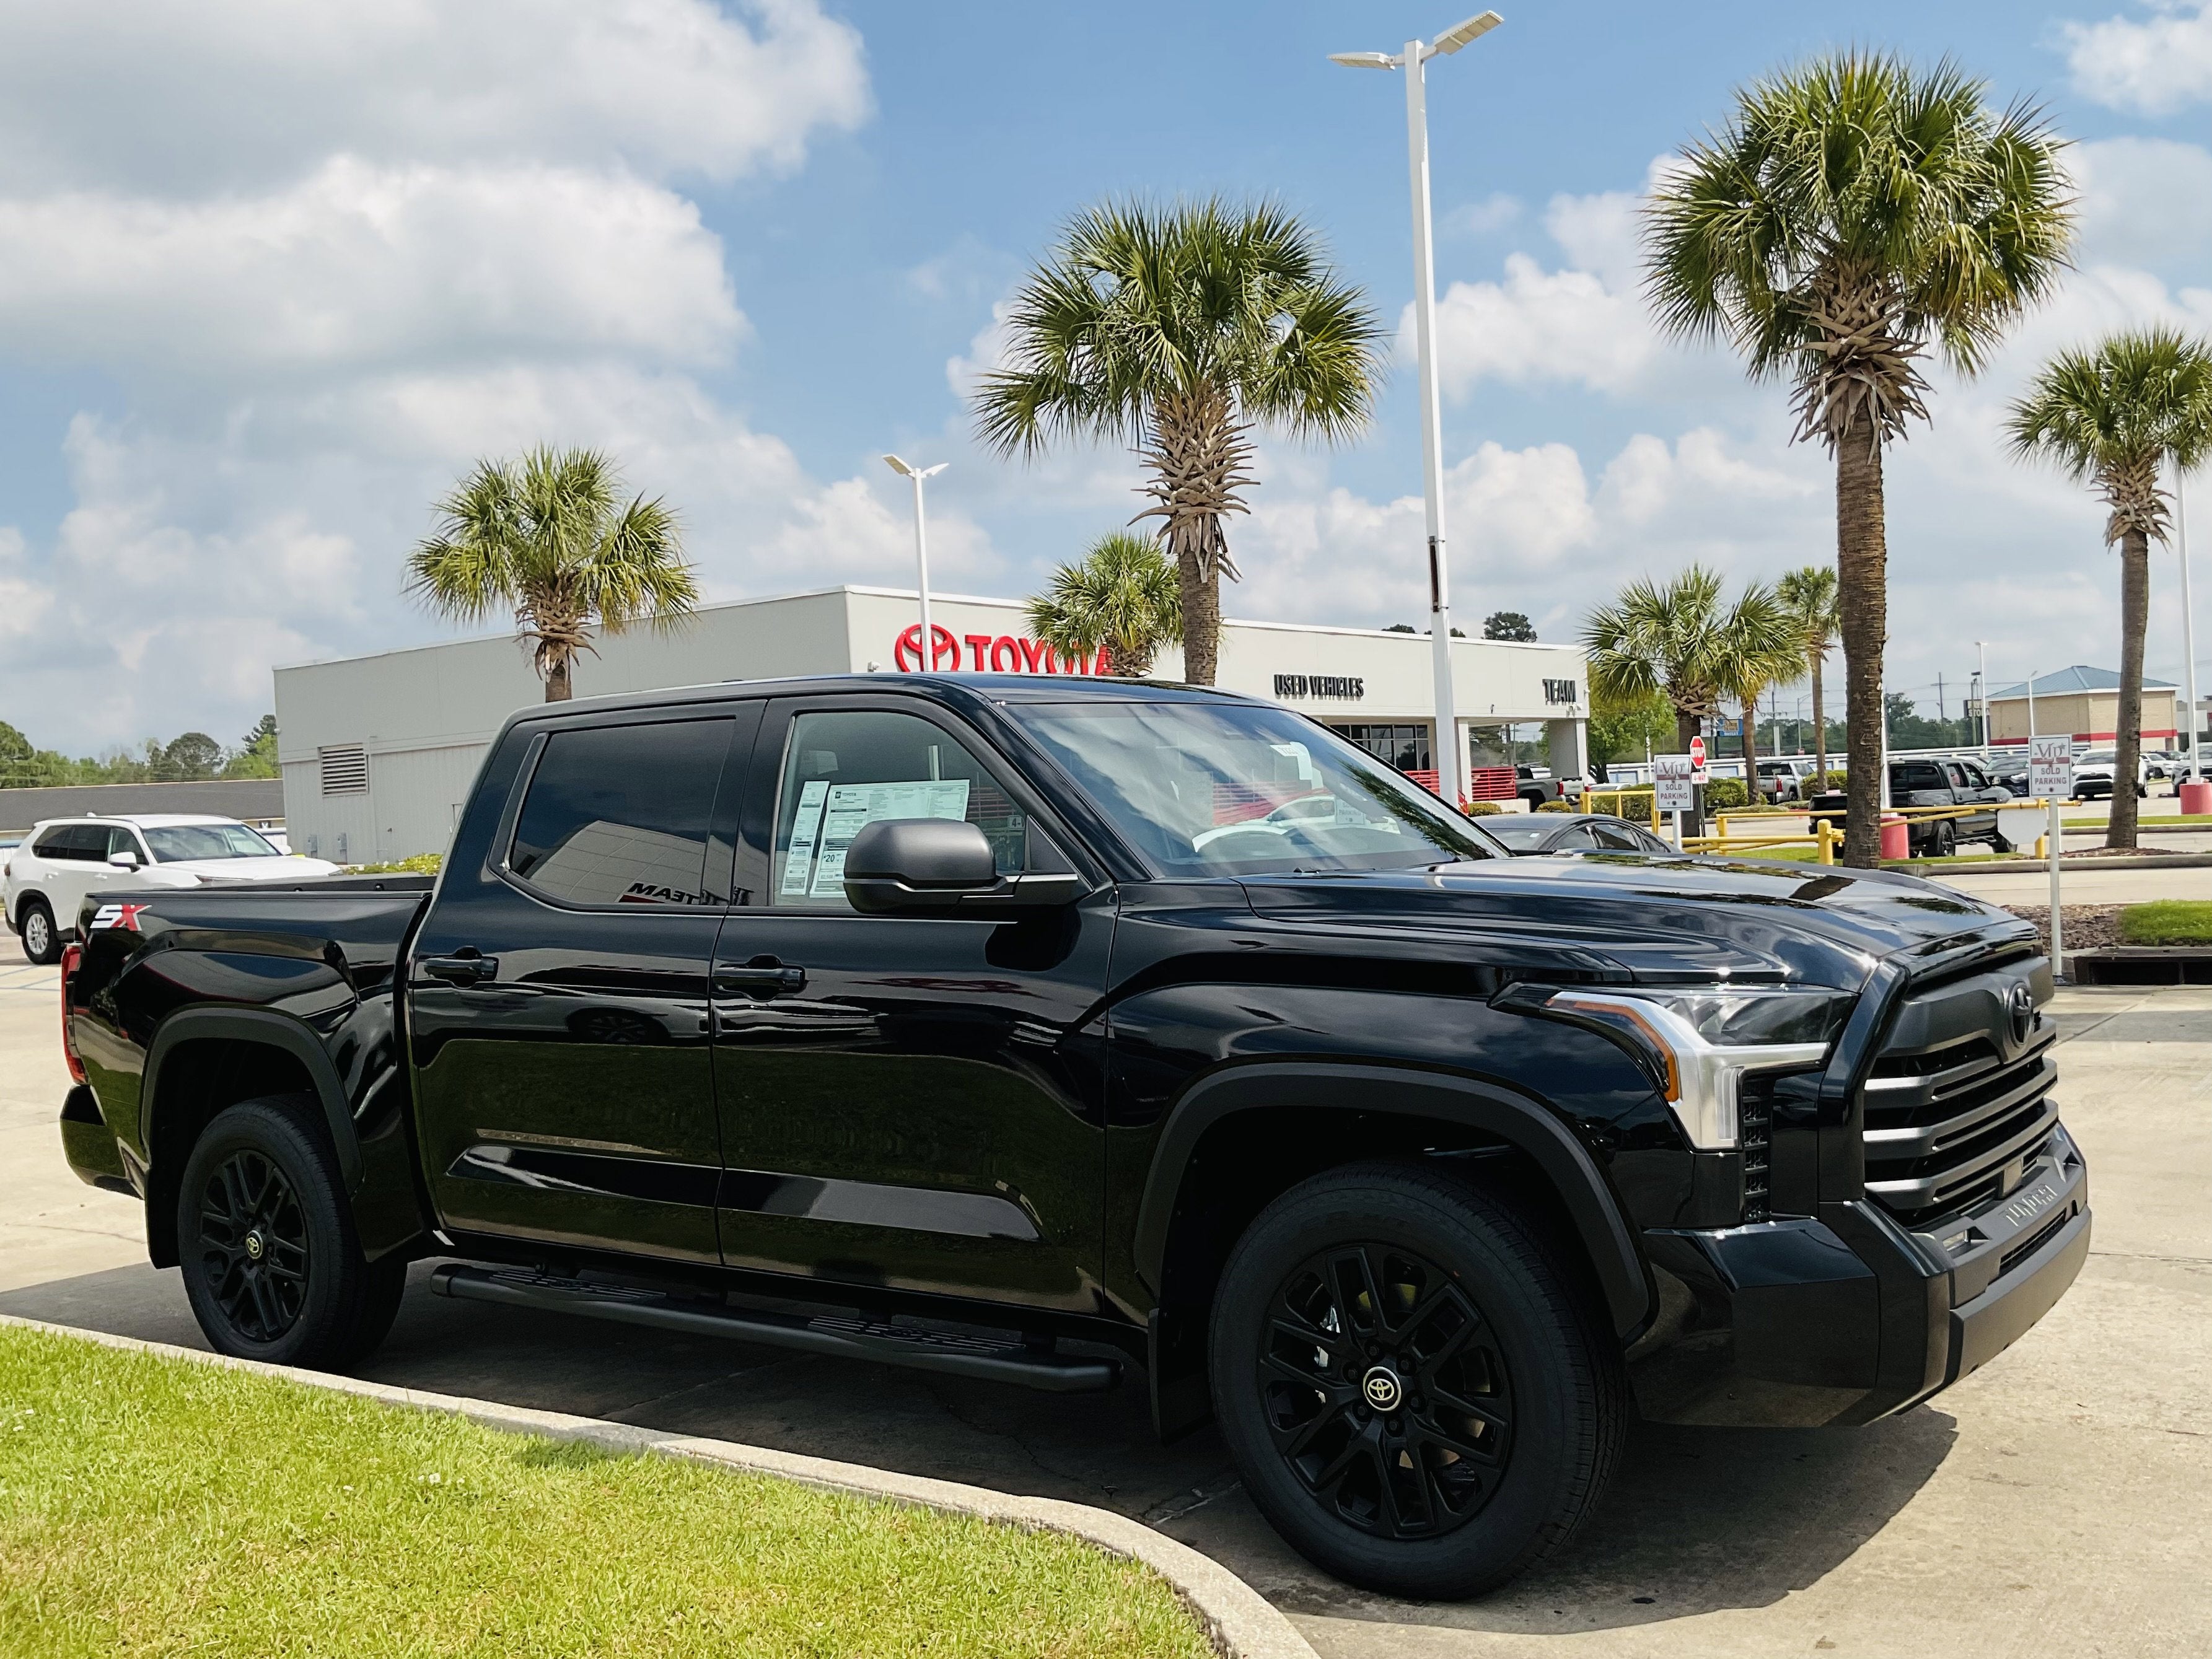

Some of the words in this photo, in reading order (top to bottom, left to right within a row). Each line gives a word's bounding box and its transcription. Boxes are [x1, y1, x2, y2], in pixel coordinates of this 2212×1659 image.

[1274, 674, 1308, 695] USED
[1309, 675, 1364, 697] VEHICLES
[1542, 678, 1576, 702] TEAM
[1691, 747, 1704, 758] STOP
[826, 854, 835, 862] 20
